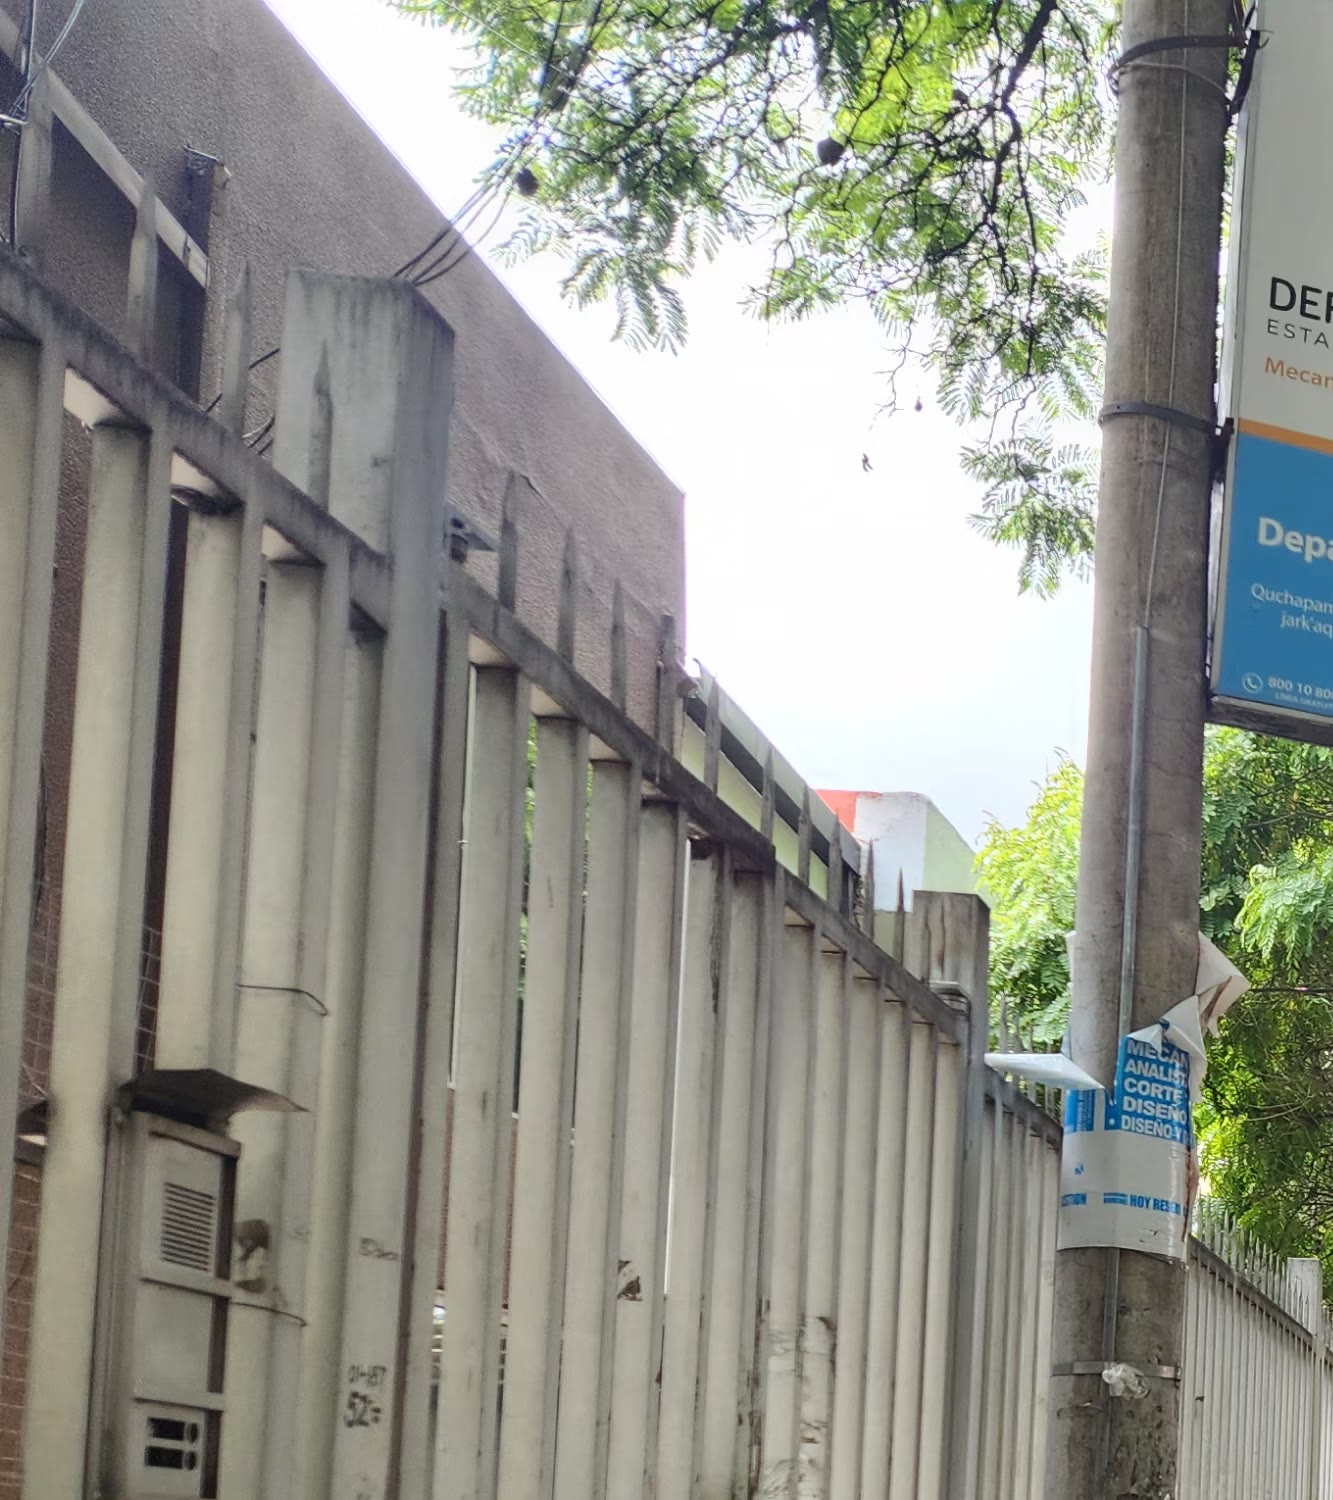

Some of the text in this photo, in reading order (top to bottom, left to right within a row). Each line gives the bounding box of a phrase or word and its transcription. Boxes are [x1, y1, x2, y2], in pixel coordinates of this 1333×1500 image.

[1268, 676, 1293, 692] 800
[1296, 683, 1313, 697] 10
[1123, 1077, 1183, 1103] CORTE
[1122, 1096, 1188, 1125] DISEÑO
[1121, 1114, 1172, 1139] DISEÑO
